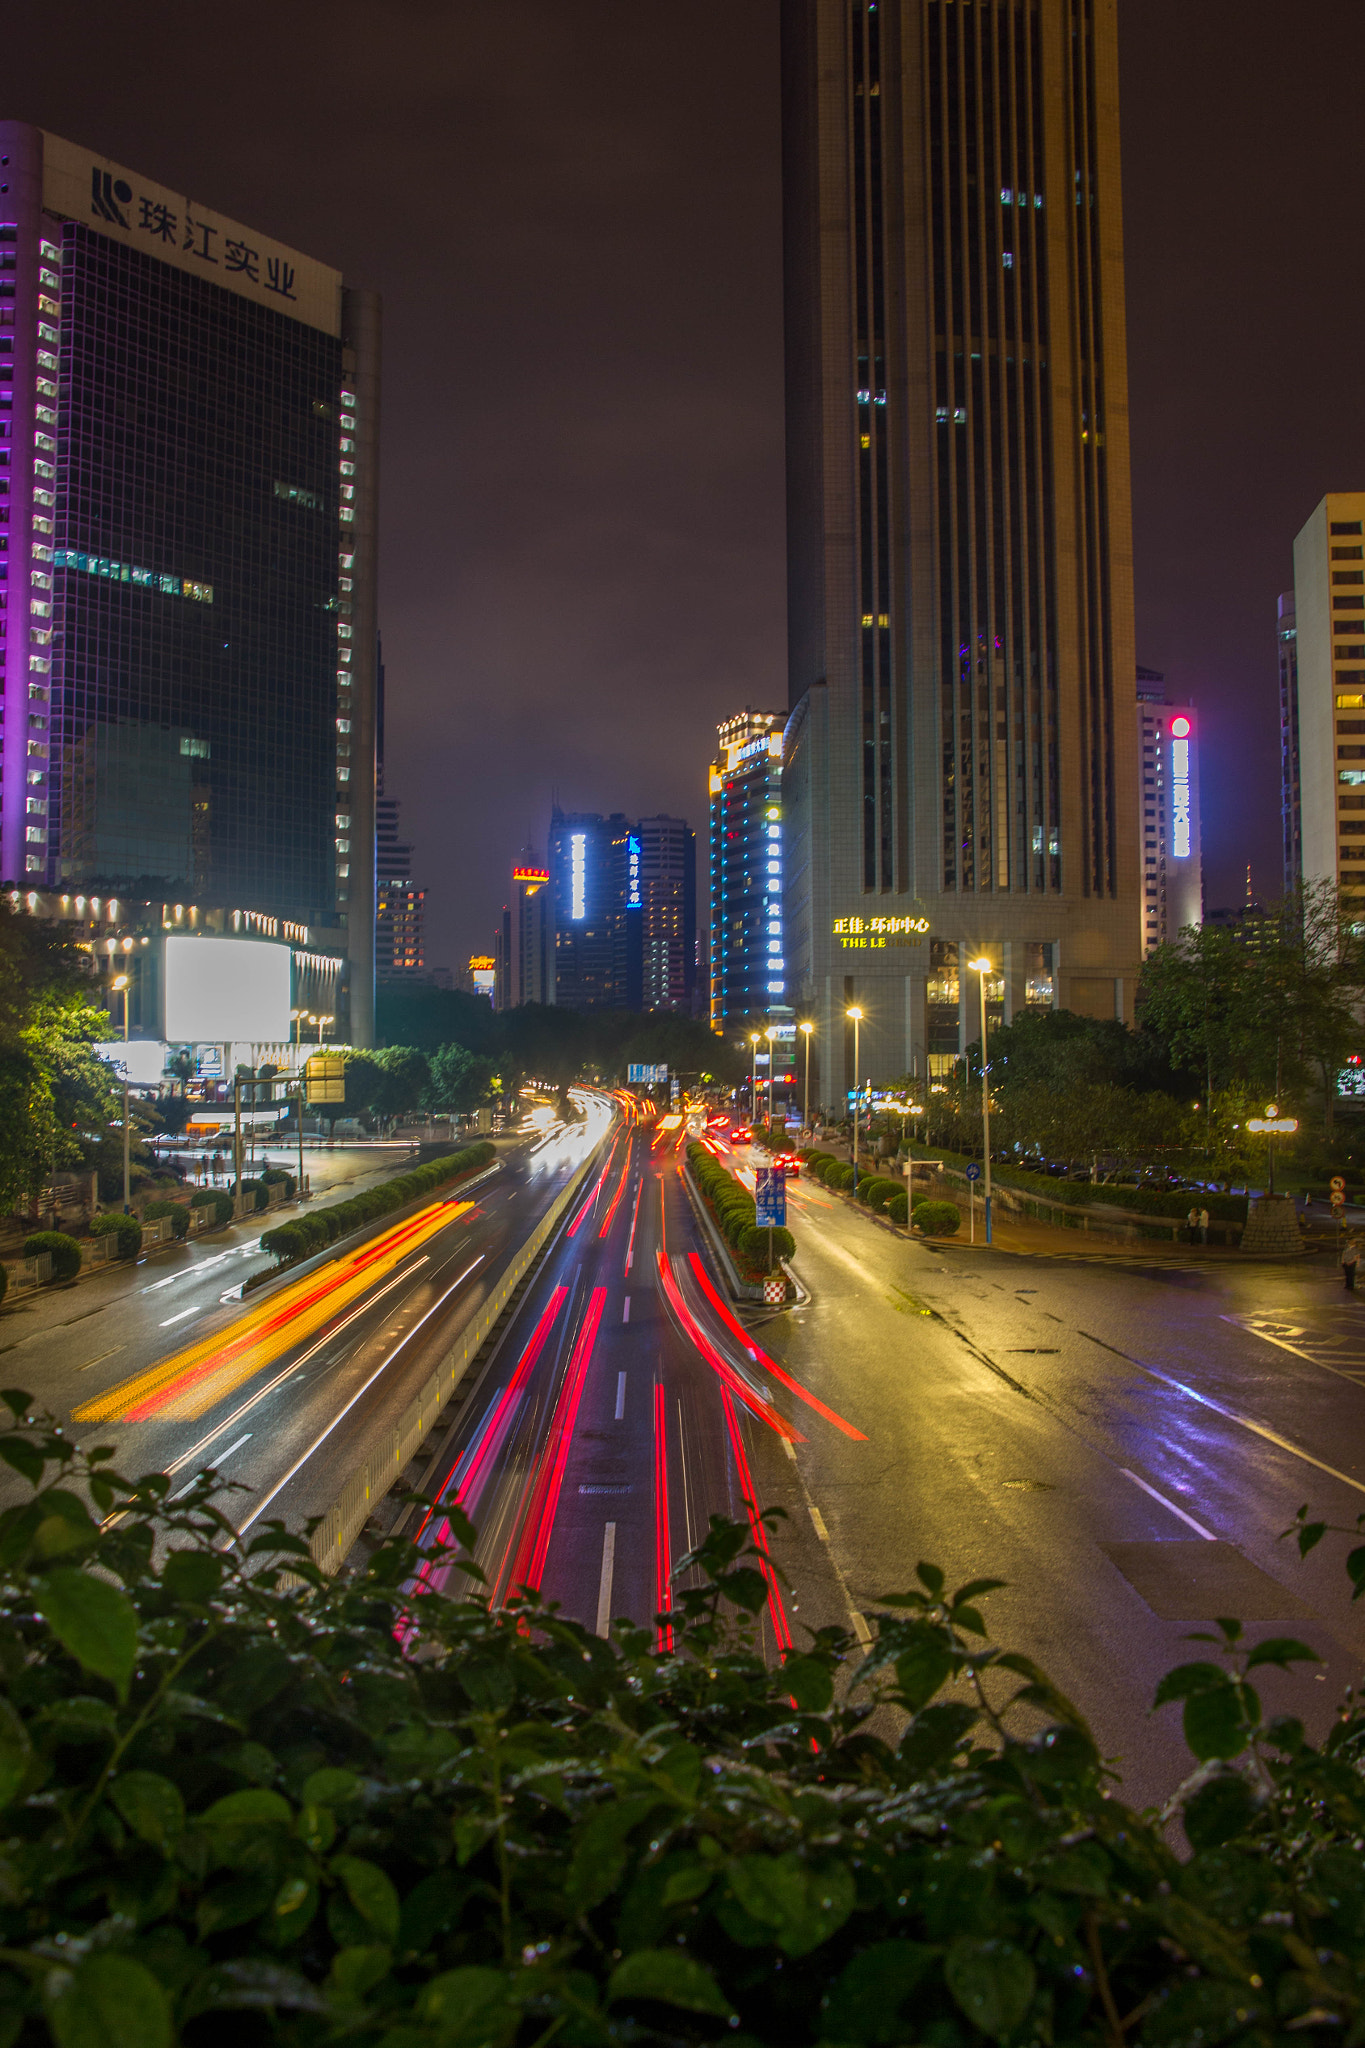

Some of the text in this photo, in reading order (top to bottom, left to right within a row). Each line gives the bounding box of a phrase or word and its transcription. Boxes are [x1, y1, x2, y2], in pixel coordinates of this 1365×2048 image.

[138, 196, 297, 300] 珠江实业
[840, 937, 868, 948] THE
